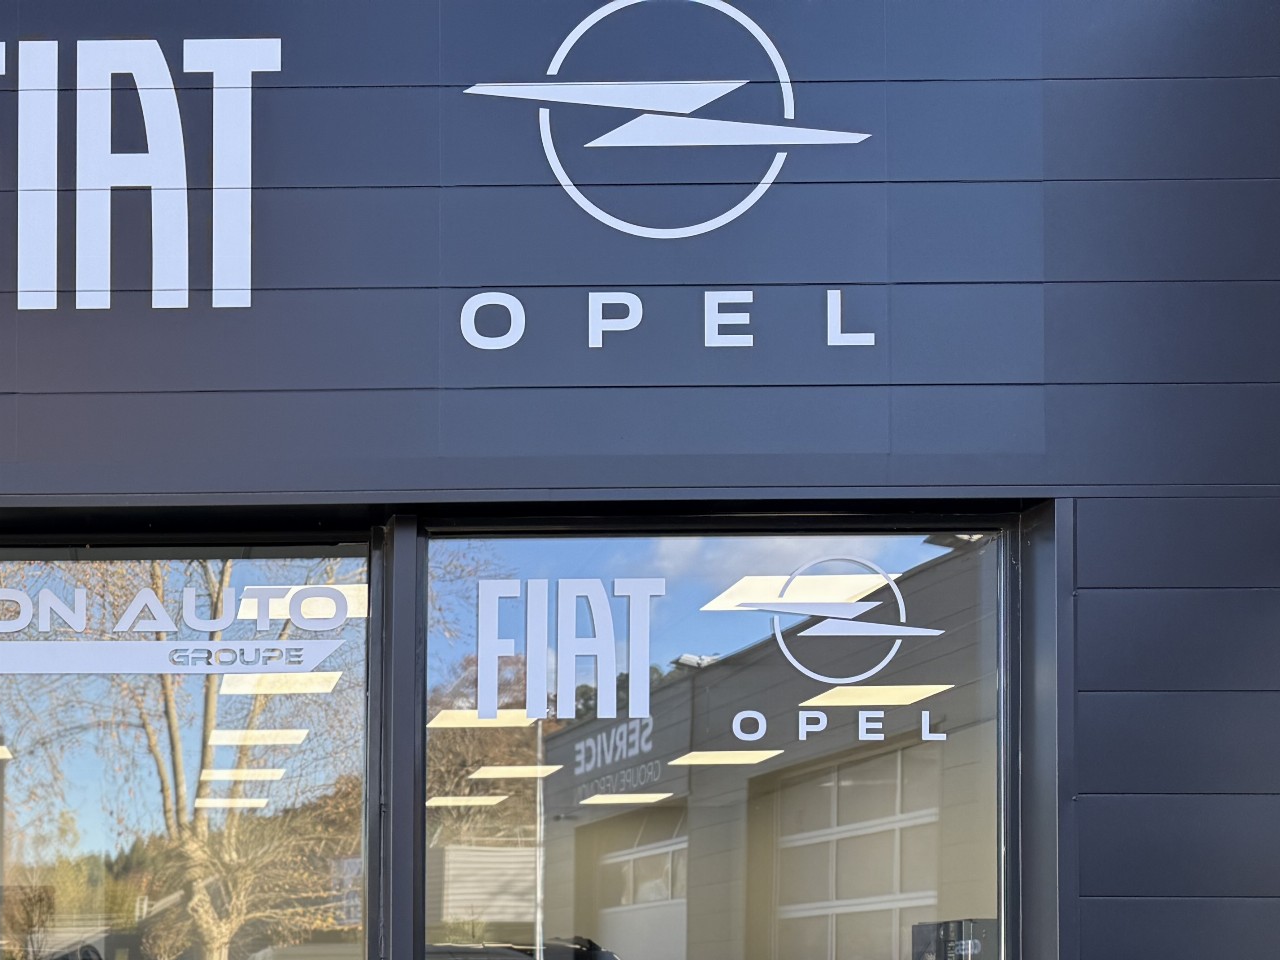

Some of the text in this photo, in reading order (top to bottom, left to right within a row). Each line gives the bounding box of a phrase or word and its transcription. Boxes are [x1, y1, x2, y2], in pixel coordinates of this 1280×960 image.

[460, 289, 875, 350] OPEL
[113, 587, 348, 632] AUTO
[168, 648, 304, 665] GROUPE
[477, 578, 666, 719] FIAT
[732, 710, 947, 741] OPEL
